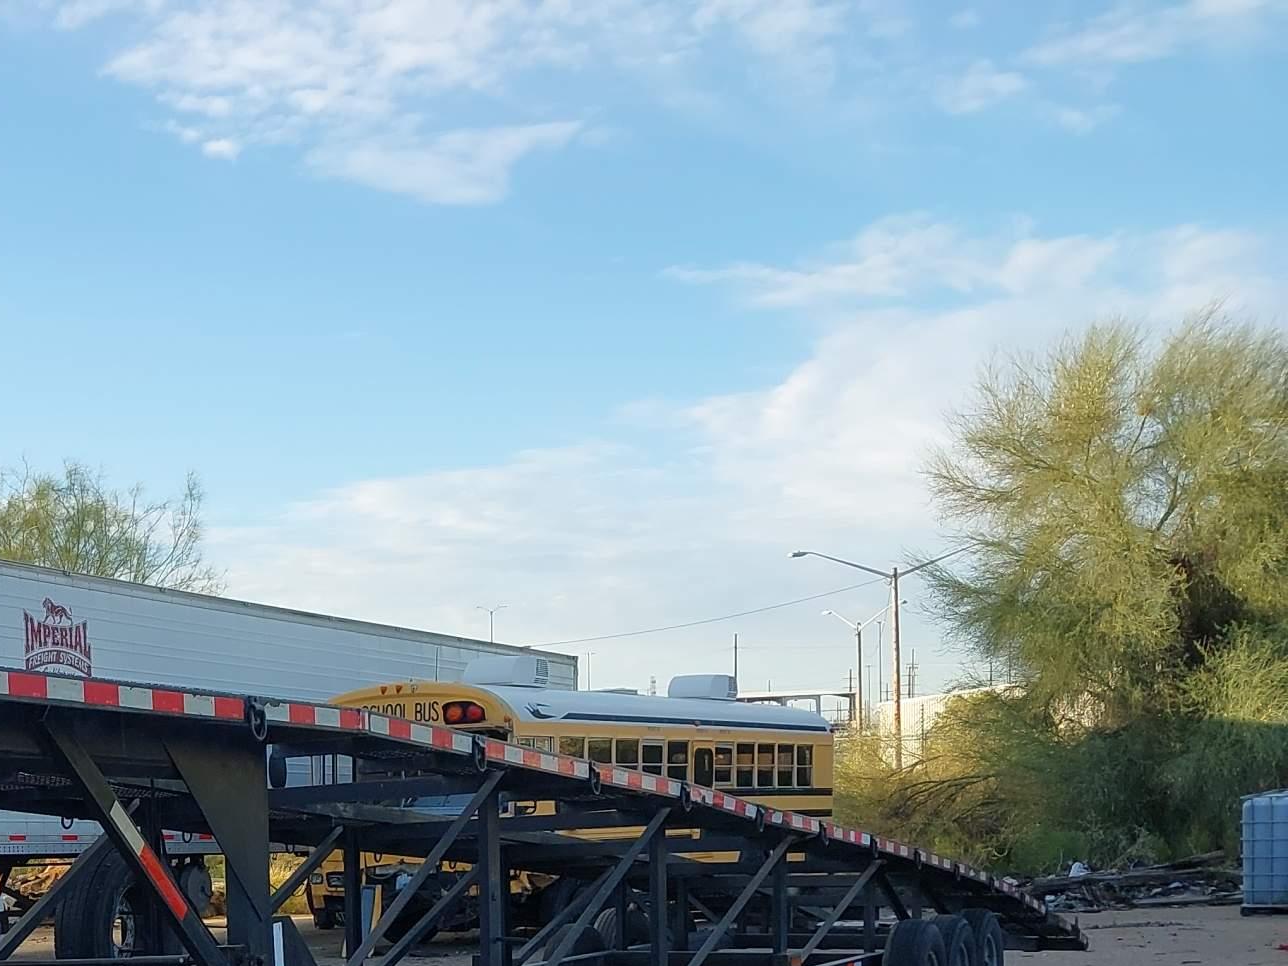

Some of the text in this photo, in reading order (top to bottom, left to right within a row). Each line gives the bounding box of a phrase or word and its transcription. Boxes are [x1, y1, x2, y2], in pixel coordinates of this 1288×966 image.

[23, 609, 91, 660] IMPERIAL
[28, 651, 57, 669] FREIGHT
[59, 651, 89, 673] SYSTEMS
[414, 701, 439, 722] BUS
